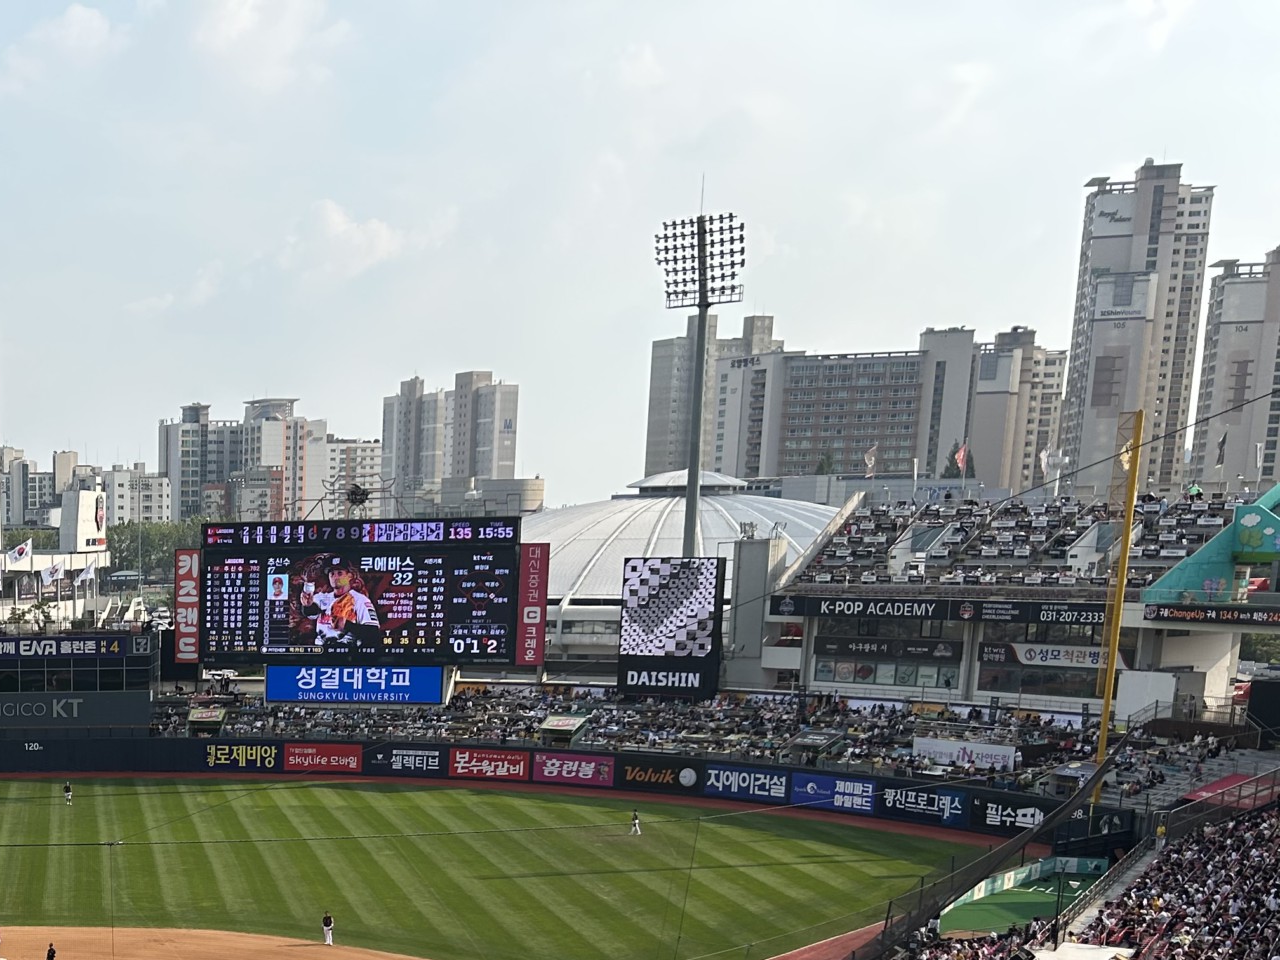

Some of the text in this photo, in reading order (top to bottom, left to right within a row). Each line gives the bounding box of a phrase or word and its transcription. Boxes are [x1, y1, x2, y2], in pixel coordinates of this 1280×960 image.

[322, 528, 331, 539] 7
[336, 527, 345, 539] 8
[350, 527, 360, 539] 9
[449, 528, 472, 539] 135
[478, 527, 514, 539] 15:55
[267, 558, 291, 567] 추신수
[360, 556, 415, 572] 쿠에바스
[391, 572, 413, 586] 32
[526, 546, 542, 602] 대신증권
[820, 601, 936, 617] K-POP ACADEMY
[1168, 608, 1205, 620] ChangeUp
[1220, 610, 1238, 620] 134.9
[20, 640, 57, 656] ENA
[60, 641, 96, 655] 홈런존
[109, 641, 119, 653] 4
[453, 640, 497, 654] 0 1 2
[296, 667, 411, 690] 성결대학교
[626, 670, 700, 688] DAISHIN
[298, 691, 410, 701] SUNGKYUL UNIVERSITY
[52, 699, 83, 718] KT
[288, 755, 328, 767] skylife
[330, 756, 358, 768] 모바일
[390, 754, 440, 771] 셀렉티브
[975, 753, 1010, 765] 자연드림
[543, 759, 596, 779] 홈런볼
[624, 766, 676, 784] Volvik
[706, 769, 787, 798] 지에이건설
[834, 780, 873, 797] 제이파크
[833, 795, 872, 811] 아일랜드
[883, 788, 962, 820] 광신프로그레스
